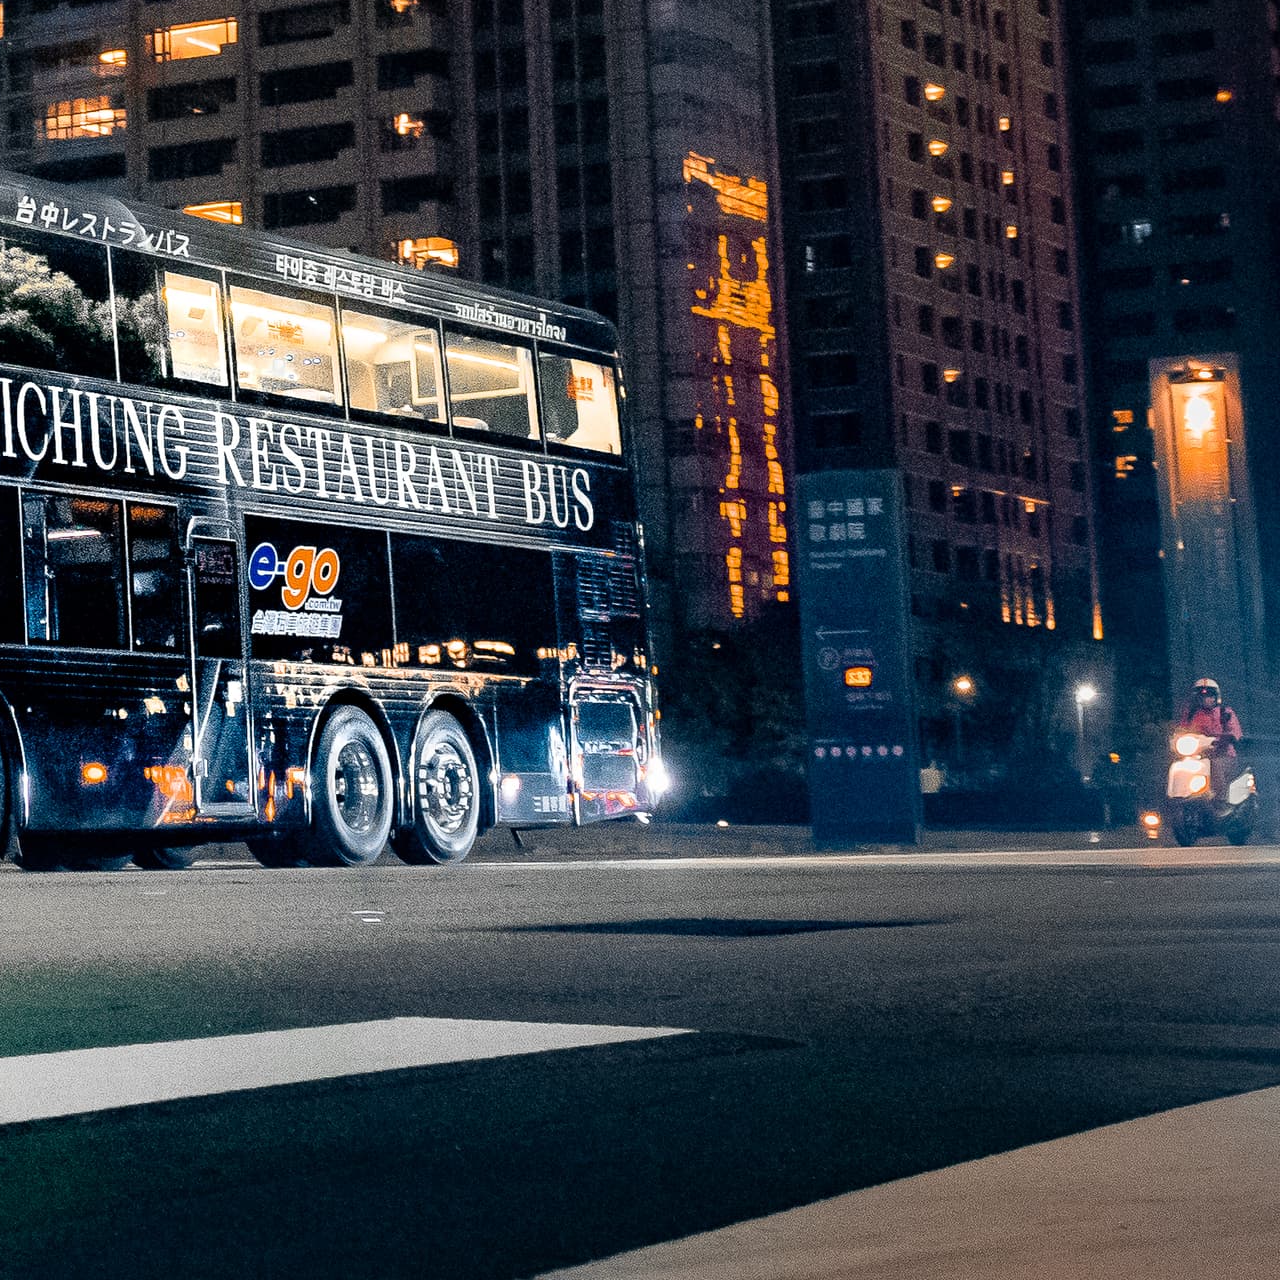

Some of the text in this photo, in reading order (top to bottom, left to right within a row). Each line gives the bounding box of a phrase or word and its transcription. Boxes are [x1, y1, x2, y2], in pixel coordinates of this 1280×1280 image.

[275, 254, 406, 303] 타이중 레스토랑 버스
[217, 412, 500, 520] RESTAURANT
[523, 459, 595, 531] BUS
[248, 542, 340, 610] e-go
